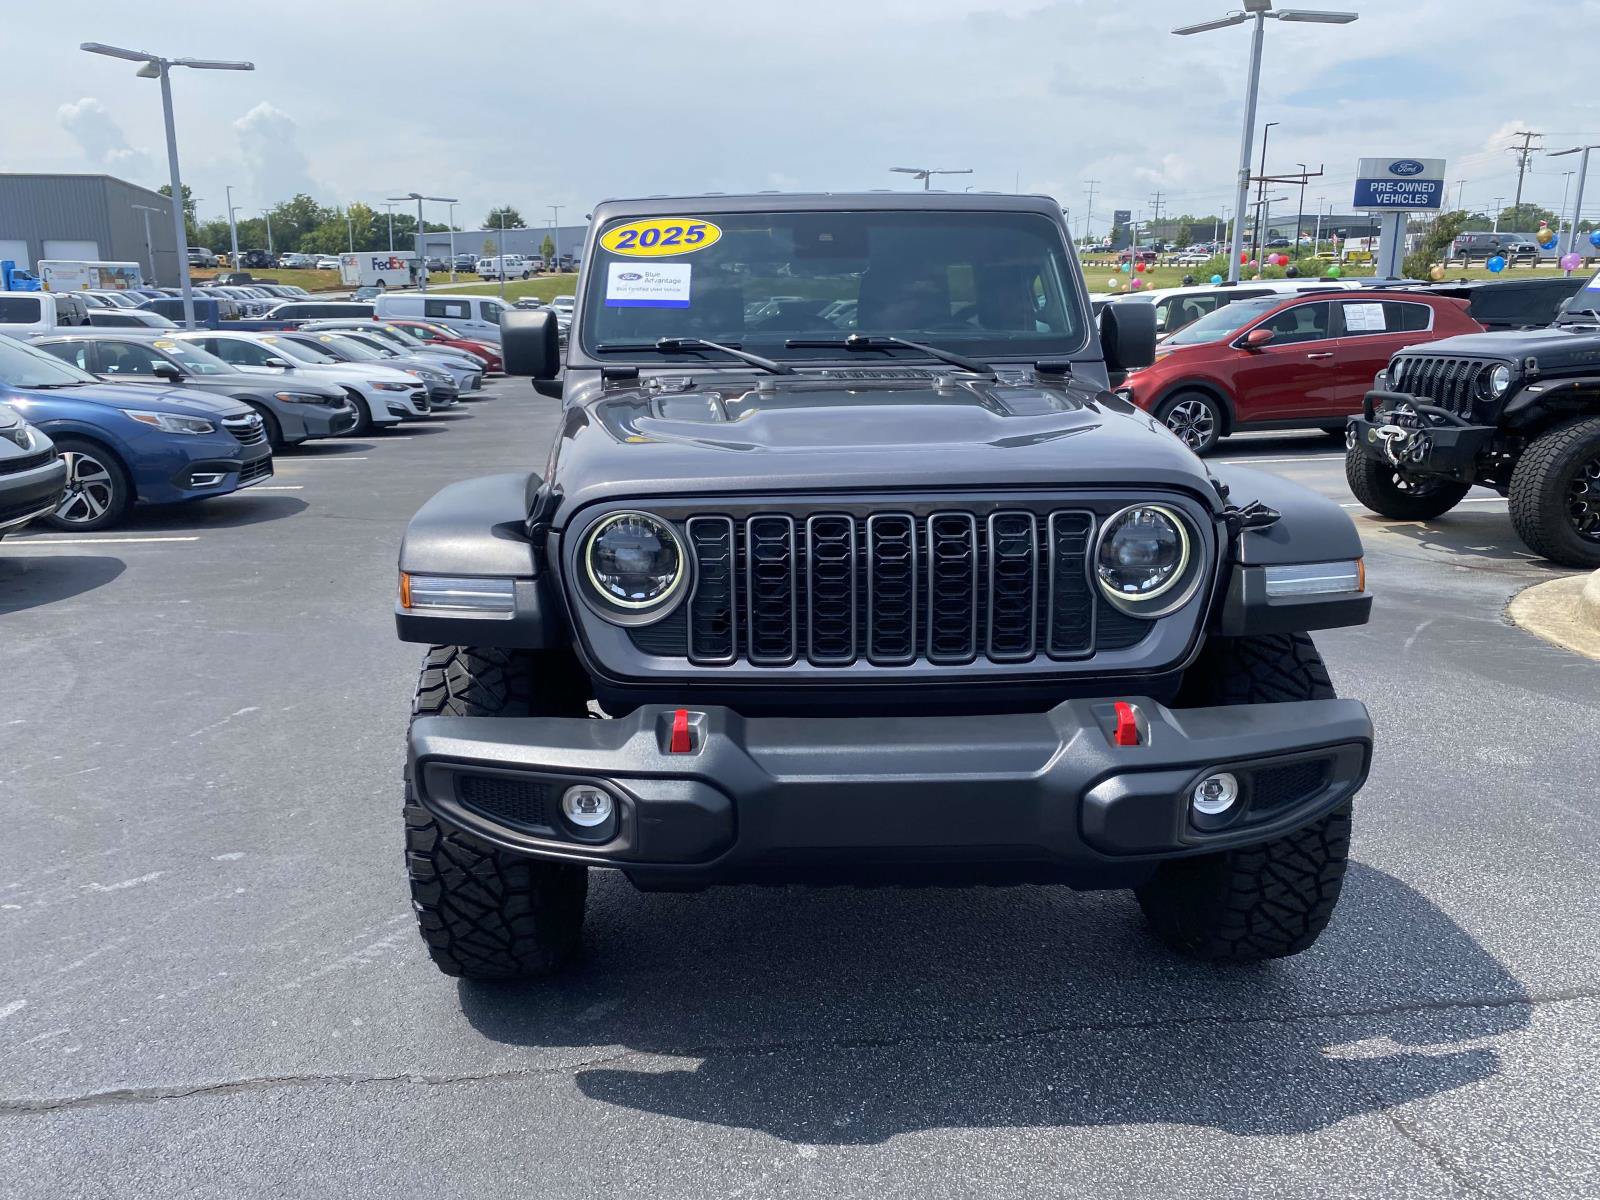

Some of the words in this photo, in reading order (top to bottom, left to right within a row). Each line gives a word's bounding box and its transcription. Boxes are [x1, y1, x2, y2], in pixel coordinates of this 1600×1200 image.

[1370, 182, 1435, 192] PRE-OWNED
[1376, 193, 1428, 204] VEHICLES
[615, 224, 706, 249] 2025
[372, 256, 405, 270] FedEx
